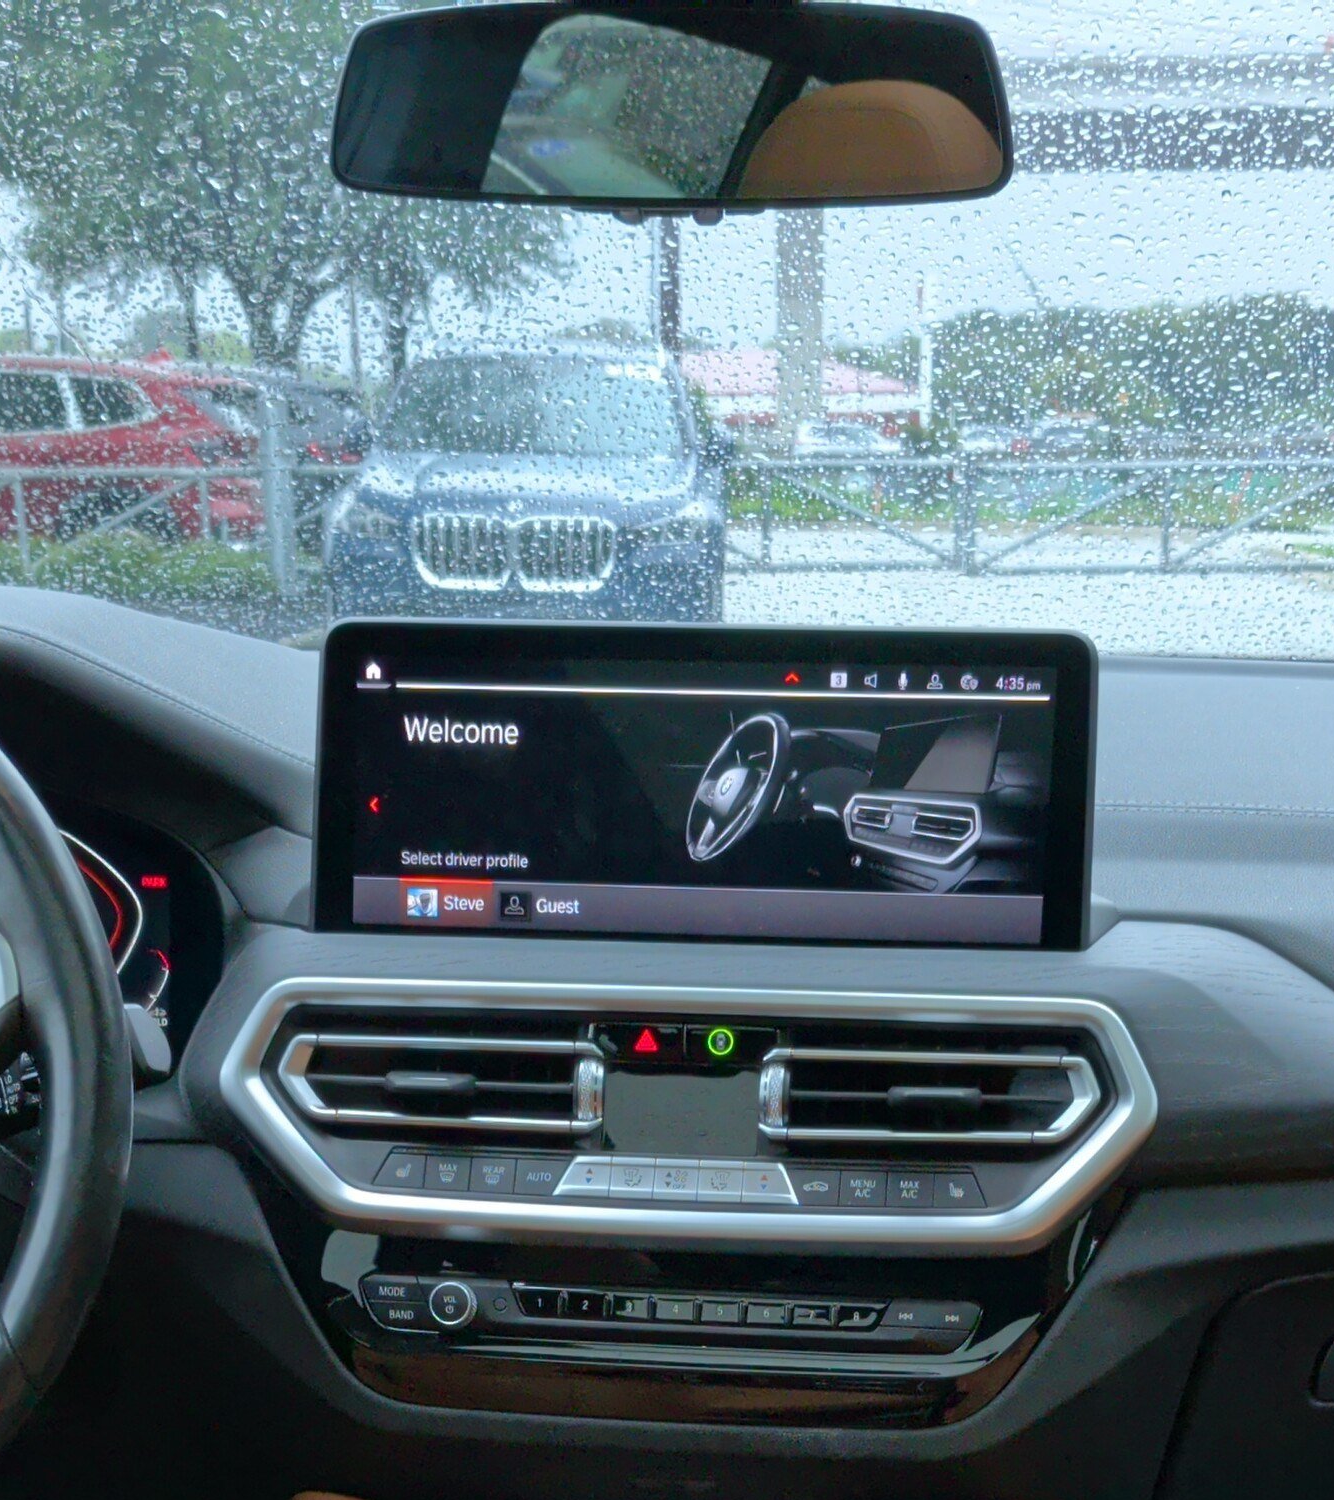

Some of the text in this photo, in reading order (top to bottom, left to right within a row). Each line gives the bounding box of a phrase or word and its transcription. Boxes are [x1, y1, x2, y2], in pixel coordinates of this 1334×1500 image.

[995, 676, 1041, 692] 4:35 pm
[403, 715, 519, 745] Welcome
[401, 851, 530, 871] Select driver profile
[141, 876, 167, 888] PARK
[443, 895, 485, 912] Steve
[535, 898, 580, 915] Guest
[438, 1163, 458, 1173] MAX
[482, 1165, 506, 1175] REAR
[526, 1171, 552, 1183] AUTO
[849, 1179, 876, 1189] MENU
[899, 1180, 920, 1190] MAX
[854, 1188, 872, 1199] A/C
[900, 1189, 919, 1200] A/C
[378, 1285, 407, 1297] MODE
[443, 1295, 457, 1304] VOL
[388, 1309, 415, 1320] BAND
